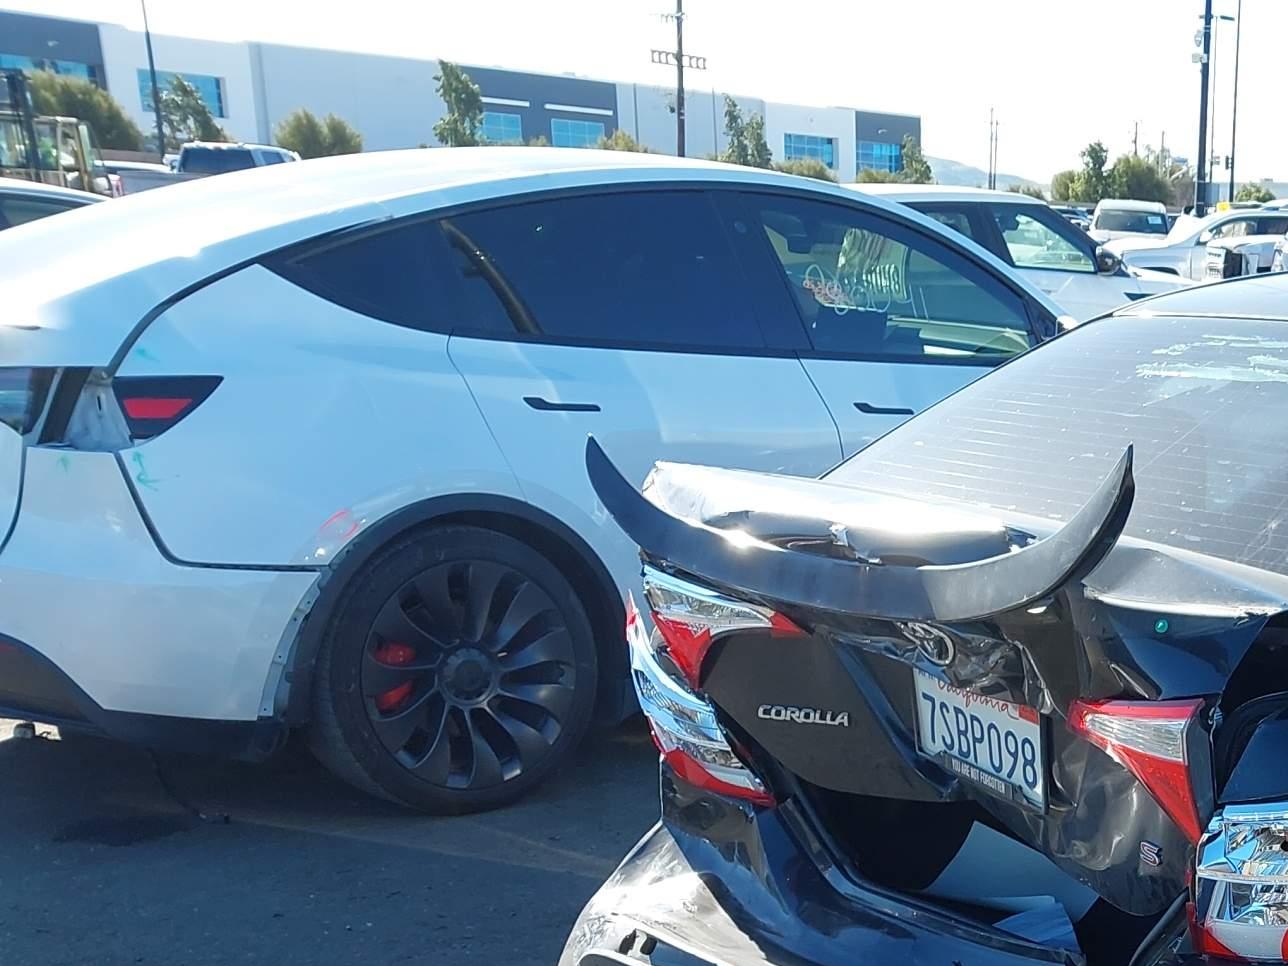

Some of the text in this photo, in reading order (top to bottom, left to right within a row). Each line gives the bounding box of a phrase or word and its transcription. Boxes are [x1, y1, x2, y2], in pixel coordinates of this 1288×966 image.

[757, 704, 849, 727] COROLLA
[921, 691, 1038, 791] 7SBP098
[951, 758, 1005, 793] YOU ARE NOT FORGOTTEN
[1140, 841, 1160, 867] S
